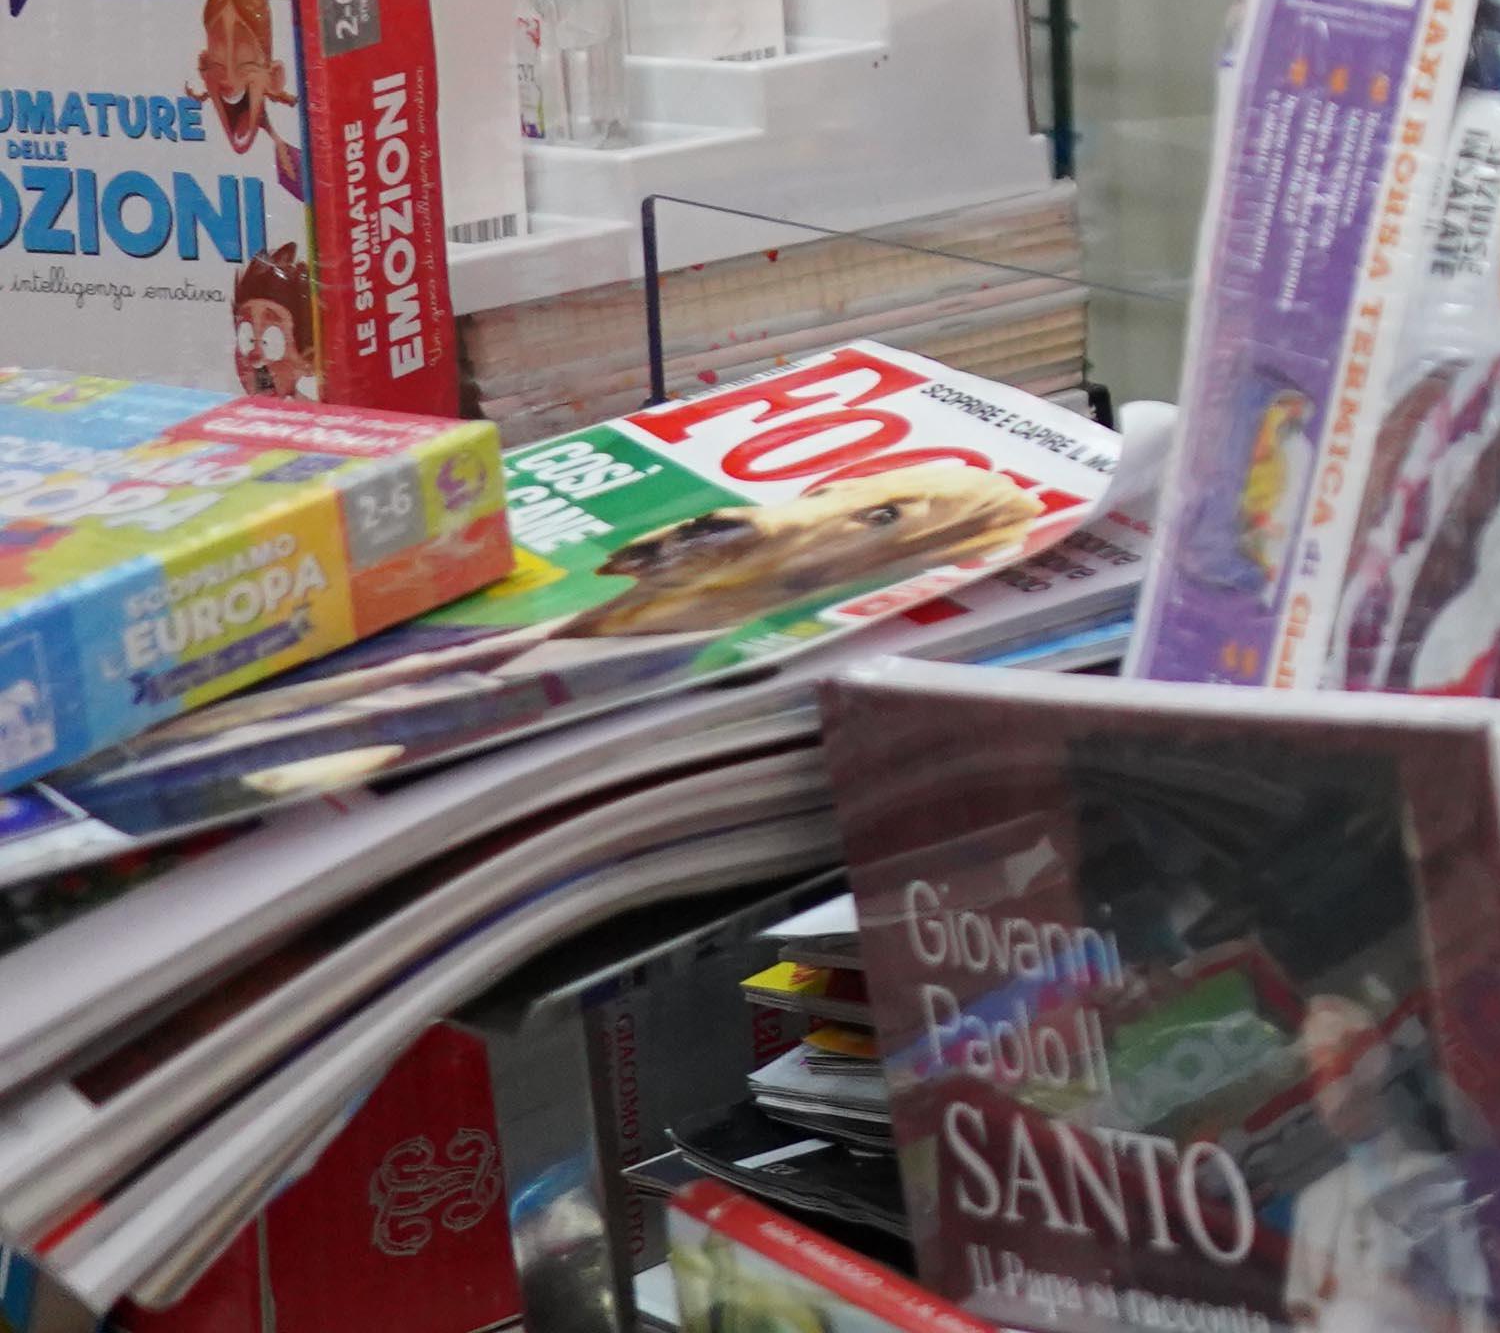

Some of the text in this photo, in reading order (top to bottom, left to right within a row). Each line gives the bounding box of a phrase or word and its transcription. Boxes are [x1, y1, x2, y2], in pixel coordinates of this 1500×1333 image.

[7, 141, 69, 162] DELLE
[1368, 116, 1428, 279] BORSA
[343, 121, 379, 357] LE SFUMATURE
[372, 72, 426, 381] EMOZIONI
[11, 266, 228, 310] intelligenza emotiva
[920, 383, 1072, 451] SCOPRIRE CAPIRE
[1308, 250, 1389, 531] TERMICA
[515, 440, 664, 499] COSÌ
[125, 533, 297, 620] SCOPRIAMO
[903, 878, 1124, 989] Giovanni
[921, 984, 1111, 1097] Paolo II
[943, 1102, 1253, 1267] SANTO
